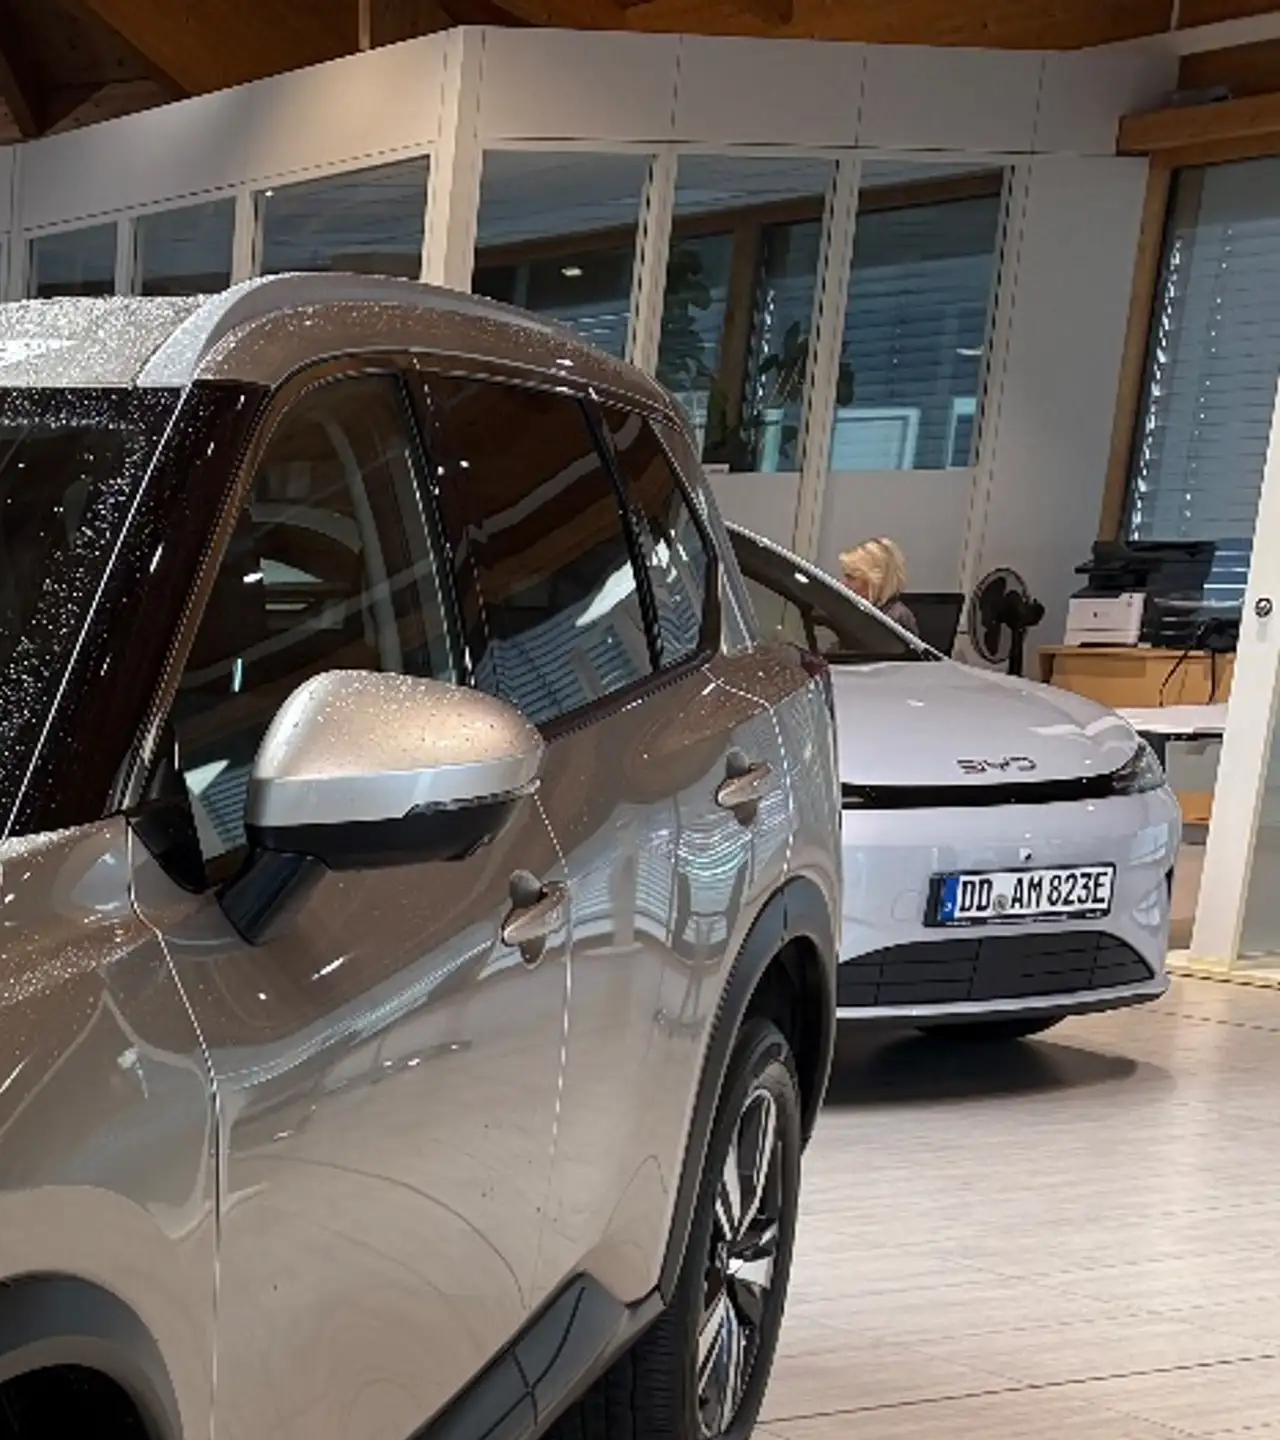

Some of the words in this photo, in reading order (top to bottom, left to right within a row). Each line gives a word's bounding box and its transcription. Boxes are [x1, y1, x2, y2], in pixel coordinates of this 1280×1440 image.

[956, 756, 1037, 775] BYD
[959, 878, 993, 913] DD
[1010, 875, 1043, 910] AM
[1047, 871, 1108, 907] 823E
